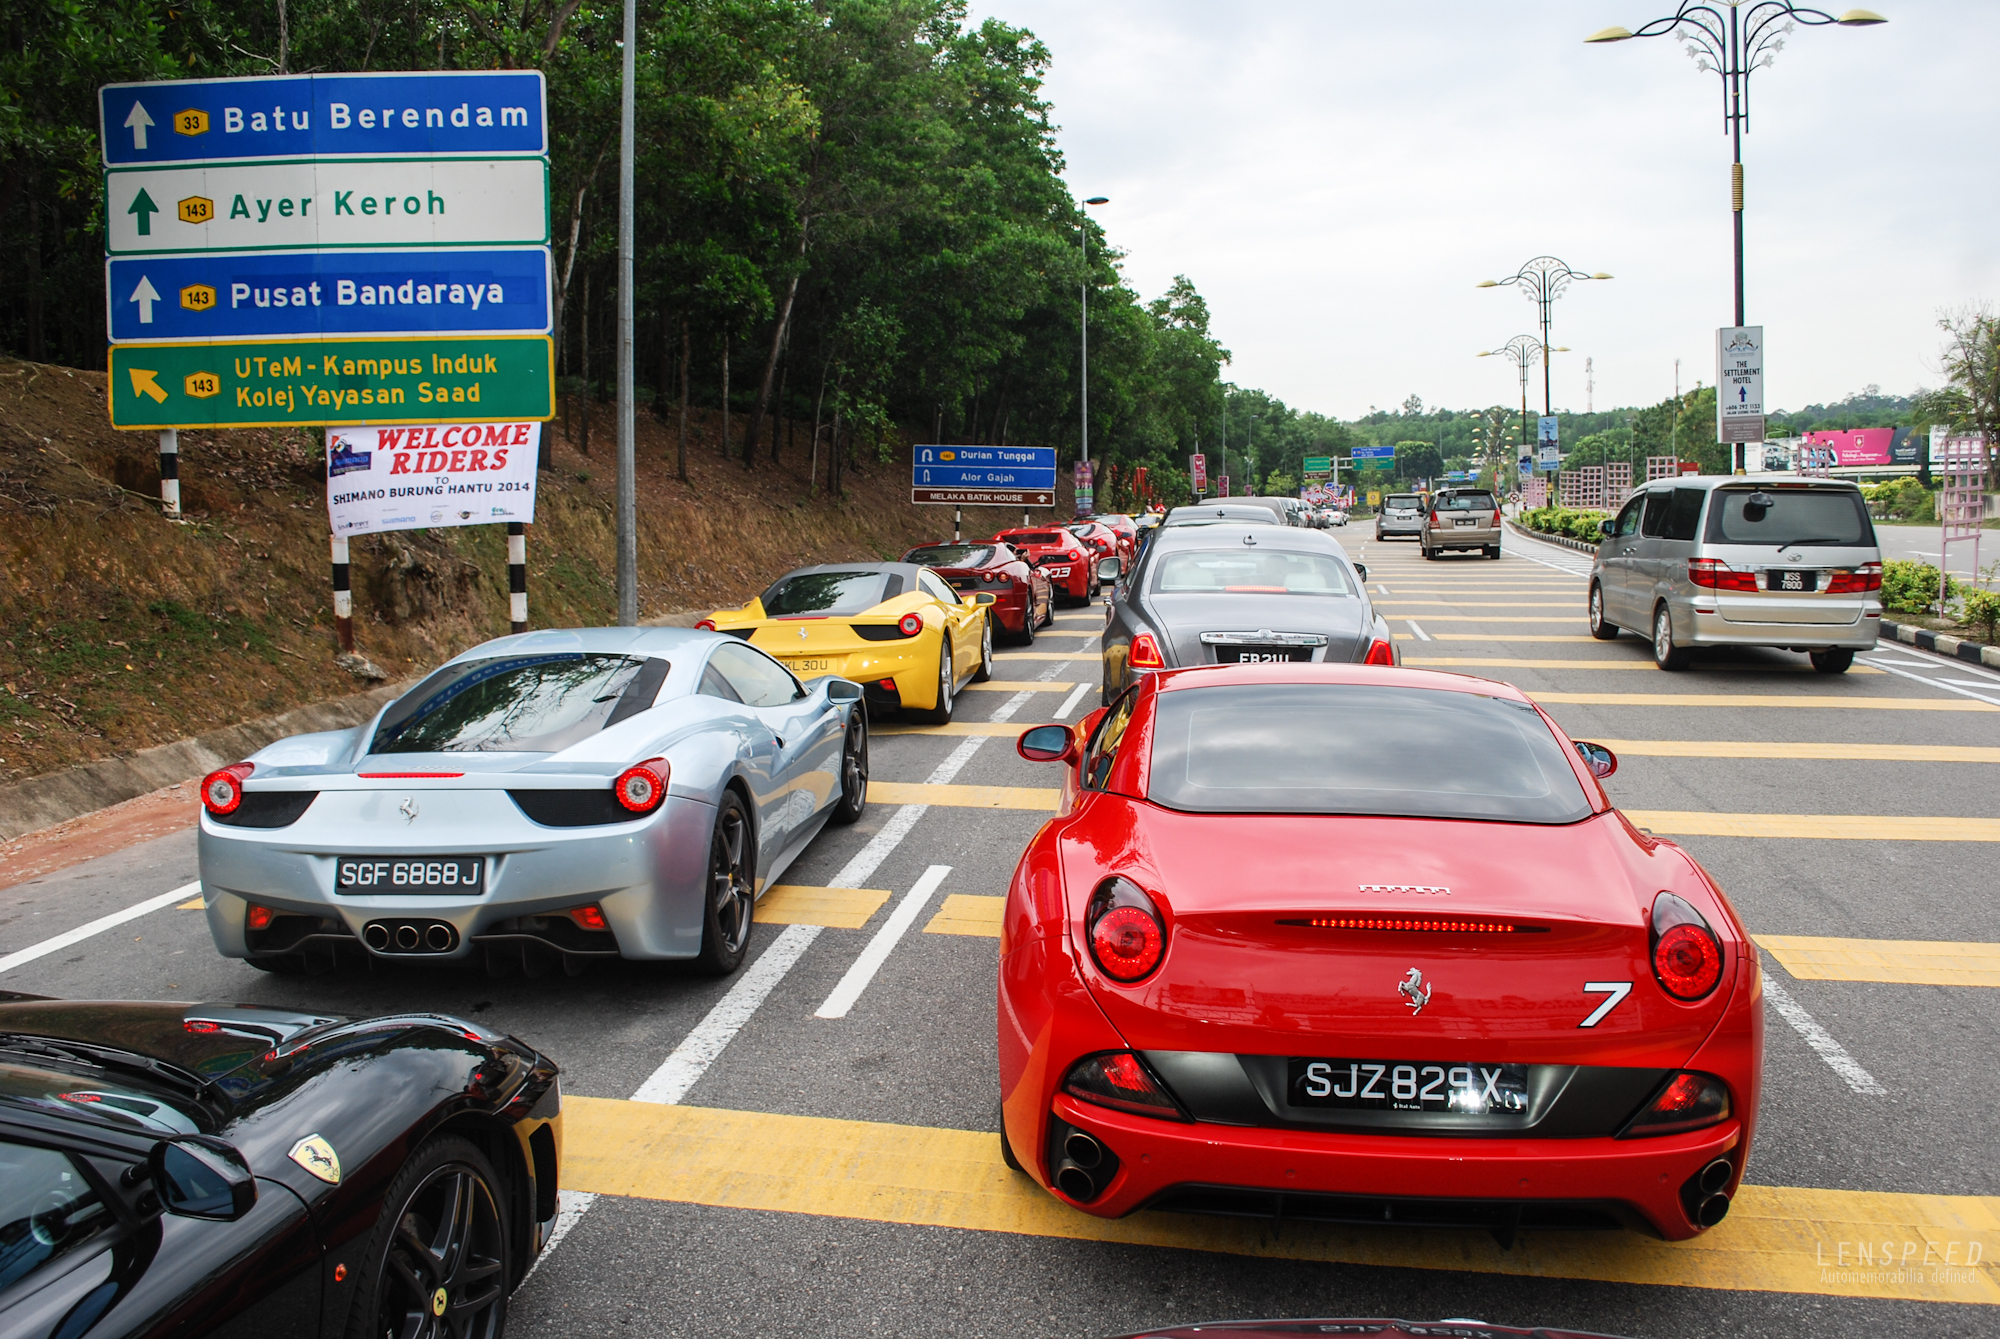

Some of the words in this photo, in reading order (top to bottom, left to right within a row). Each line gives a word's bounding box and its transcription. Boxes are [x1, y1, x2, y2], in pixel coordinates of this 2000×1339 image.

[184, 116, 201, 130] 33
[225, 106, 310, 133] Batu
[330, 102, 529, 130] Berendam
[185, 203, 208, 218] 143
[230, 194, 313, 222] Ayer
[334, 190, 446, 215] Keroh
[187, 291, 209, 305] 143
[231, 281, 321, 309] Pusat
[337, 278, 504, 311] Bandaraya
[235, 356, 302, 378] UTeM
[324, 355, 422, 378] Kampus
[432, 352, 498, 375] Induk
[1723, 368, 1761, 377] SETTLEMENT
[191, 378, 214, 393] 143
[236, 386, 295, 413] Kolej
[301, 385, 404, 411] Yayasan
[418, 381, 481, 403] Saad
[377, 424, 531, 451] WELCOME
[389, 449, 509, 475] RIDERS
[961, 450, 993, 460] Durian
[997, 451, 1035, 463] Tunggal
[435, 477, 450, 485] TO
[961, 472, 982, 482] Alor
[987, 473, 1015, 484] Gajah
[333, 489, 385, 505] SHIMANO
[389, 485, 443, 498] BURUNG
[449, 483, 493, 494] HANTU
[497, 482, 530, 492] 2014
[967, 493, 992, 501] BATIK
[994, 494, 1023, 502] HOUSE
[781, 660, 800, 671] KL
[1576, 981, 1635, 1029] 7
